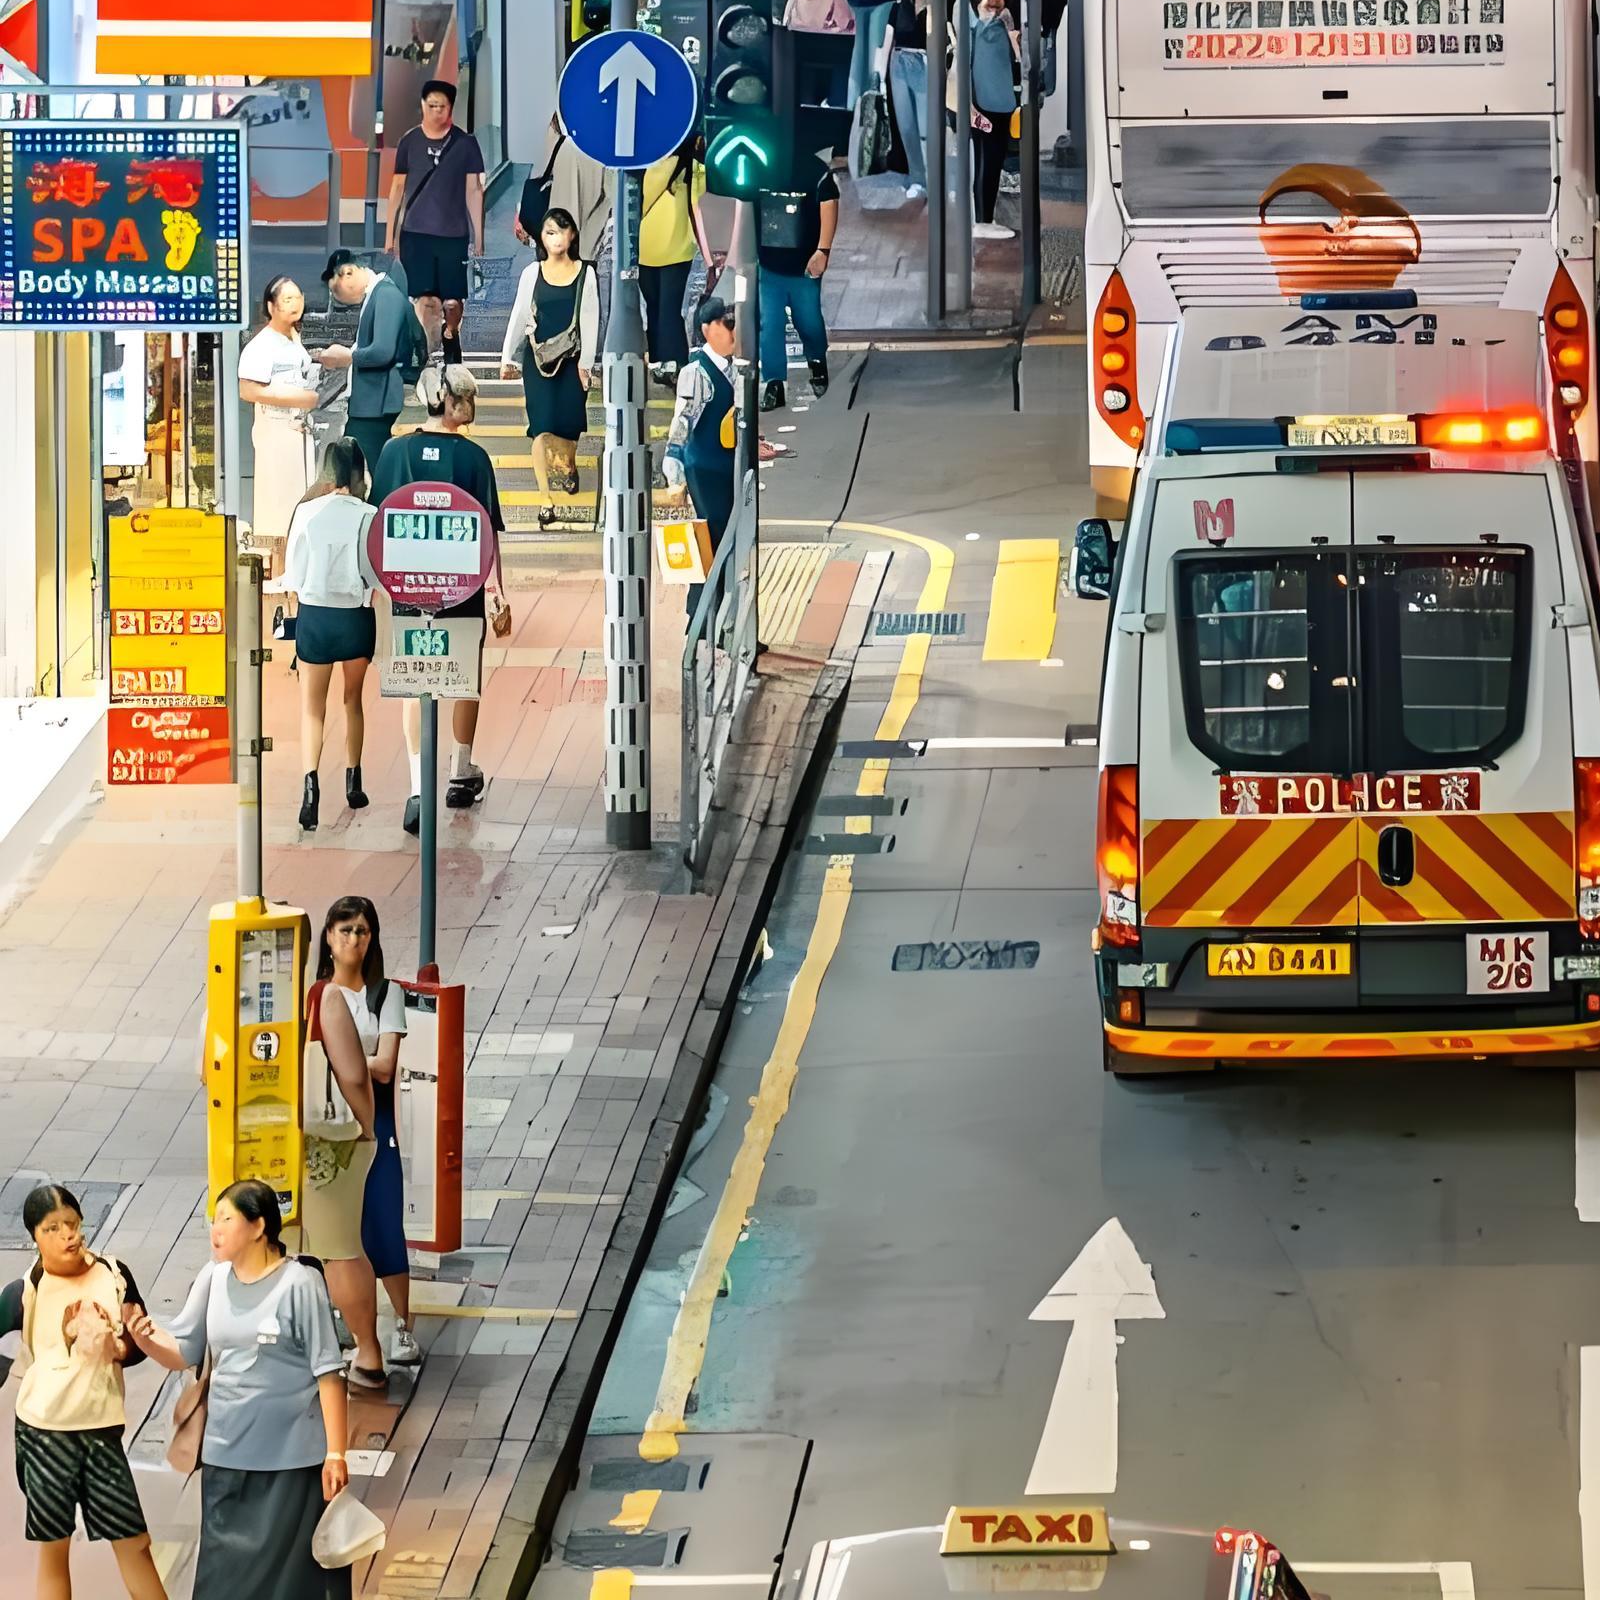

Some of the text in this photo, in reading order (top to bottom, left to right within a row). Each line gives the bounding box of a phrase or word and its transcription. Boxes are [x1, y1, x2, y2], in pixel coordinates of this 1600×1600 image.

[32, 217, 149, 263] SPA
[18, 268, 215, 300] Body Massage
[1277, 776, 1422, 813] POLICE
[959, 1513, 1094, 1544] TAXI
